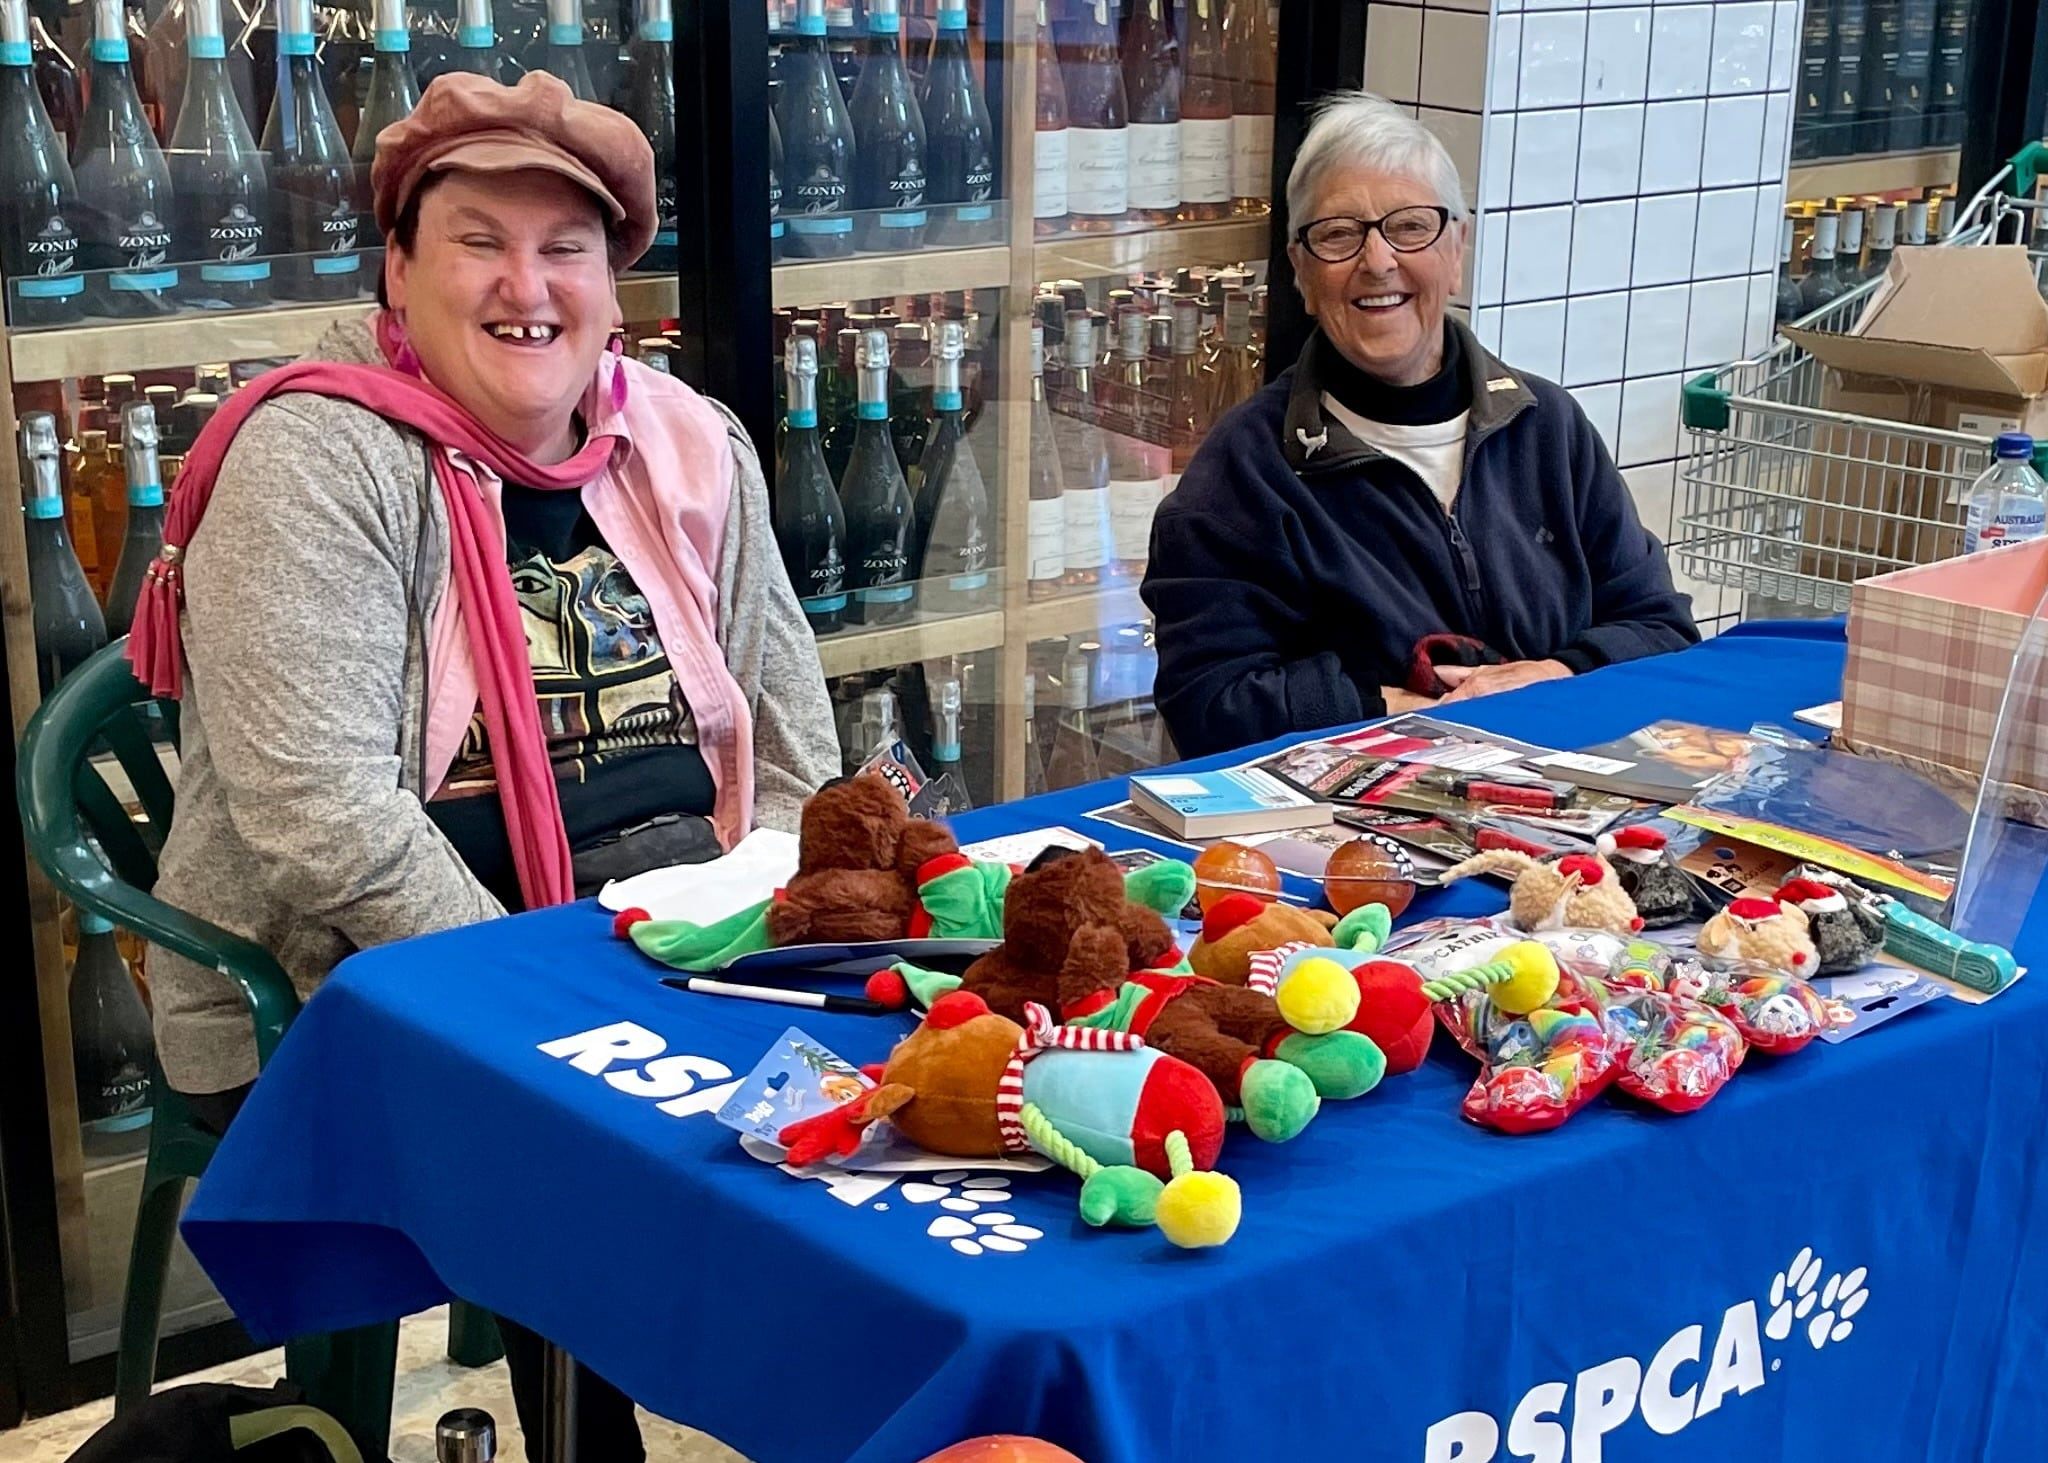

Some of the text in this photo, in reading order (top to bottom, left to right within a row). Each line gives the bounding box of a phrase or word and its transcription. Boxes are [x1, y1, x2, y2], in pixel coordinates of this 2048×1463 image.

[797, 183, 846, 196] ZONIN
[210, 225, 263, 239] ZONIN
[27, 237, 79, 253] ZONIN
[119, 232, 172, 248] ZONIN
[863, 556, 908, 568] ZONIN
[101, 1077, 151, 1097] ZONIN
